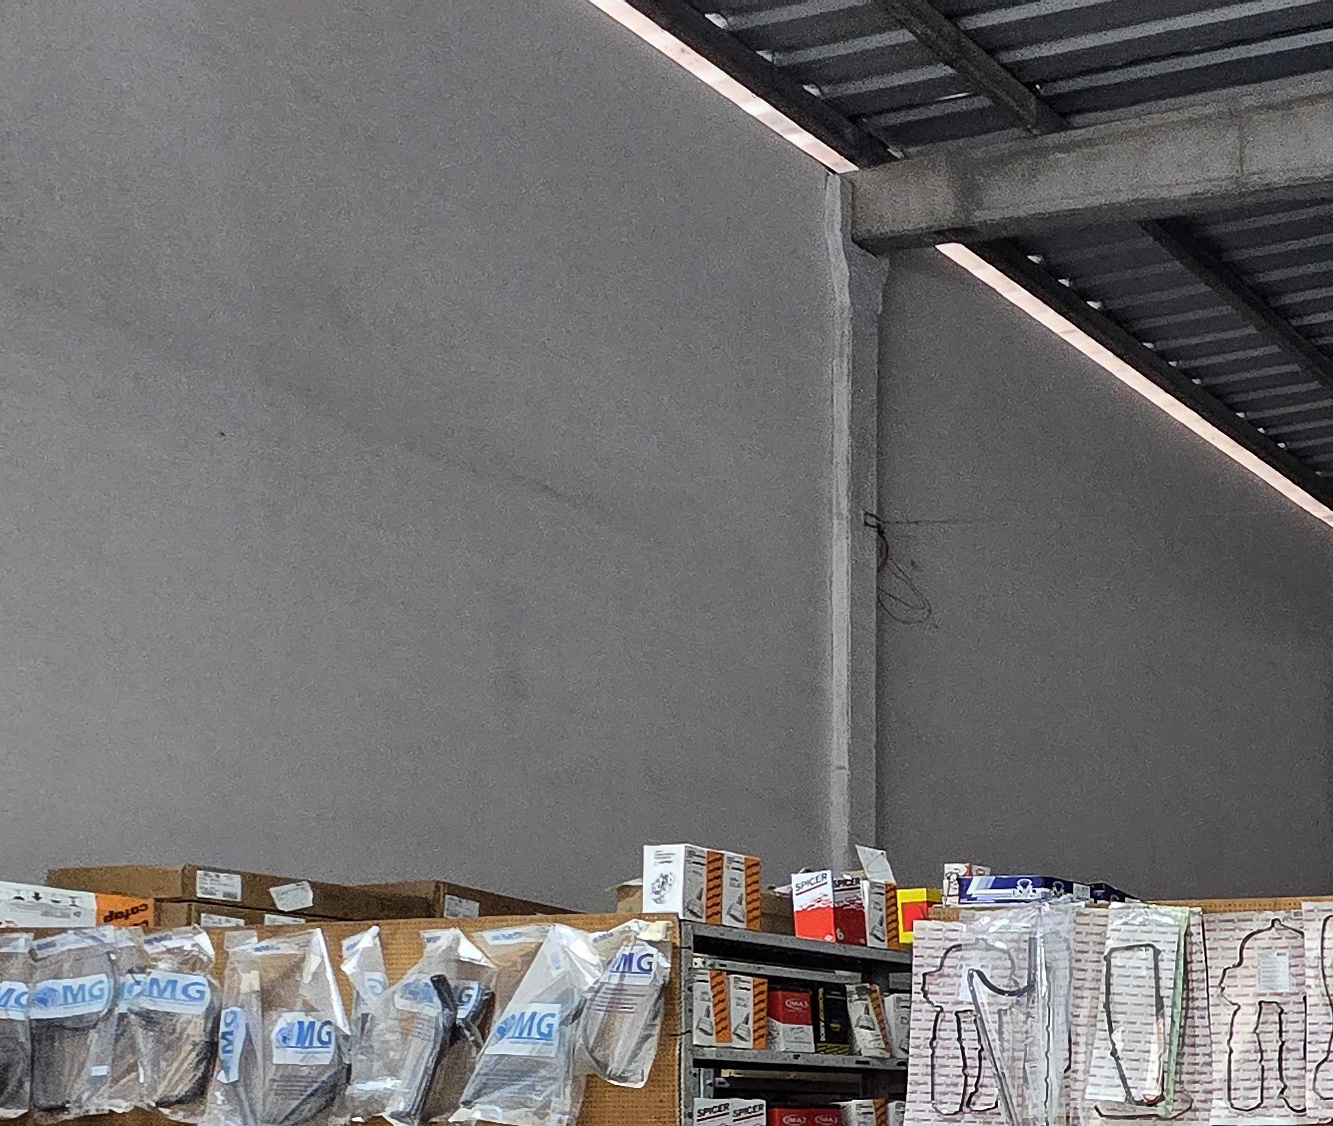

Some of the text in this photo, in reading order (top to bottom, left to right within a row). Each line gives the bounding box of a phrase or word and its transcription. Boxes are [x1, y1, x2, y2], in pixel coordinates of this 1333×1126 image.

[795, 873, 827, 891] SPICER
[697, 1103, 730, 1117] SPICER
[733, 1104, 764, 1118] SPICER
